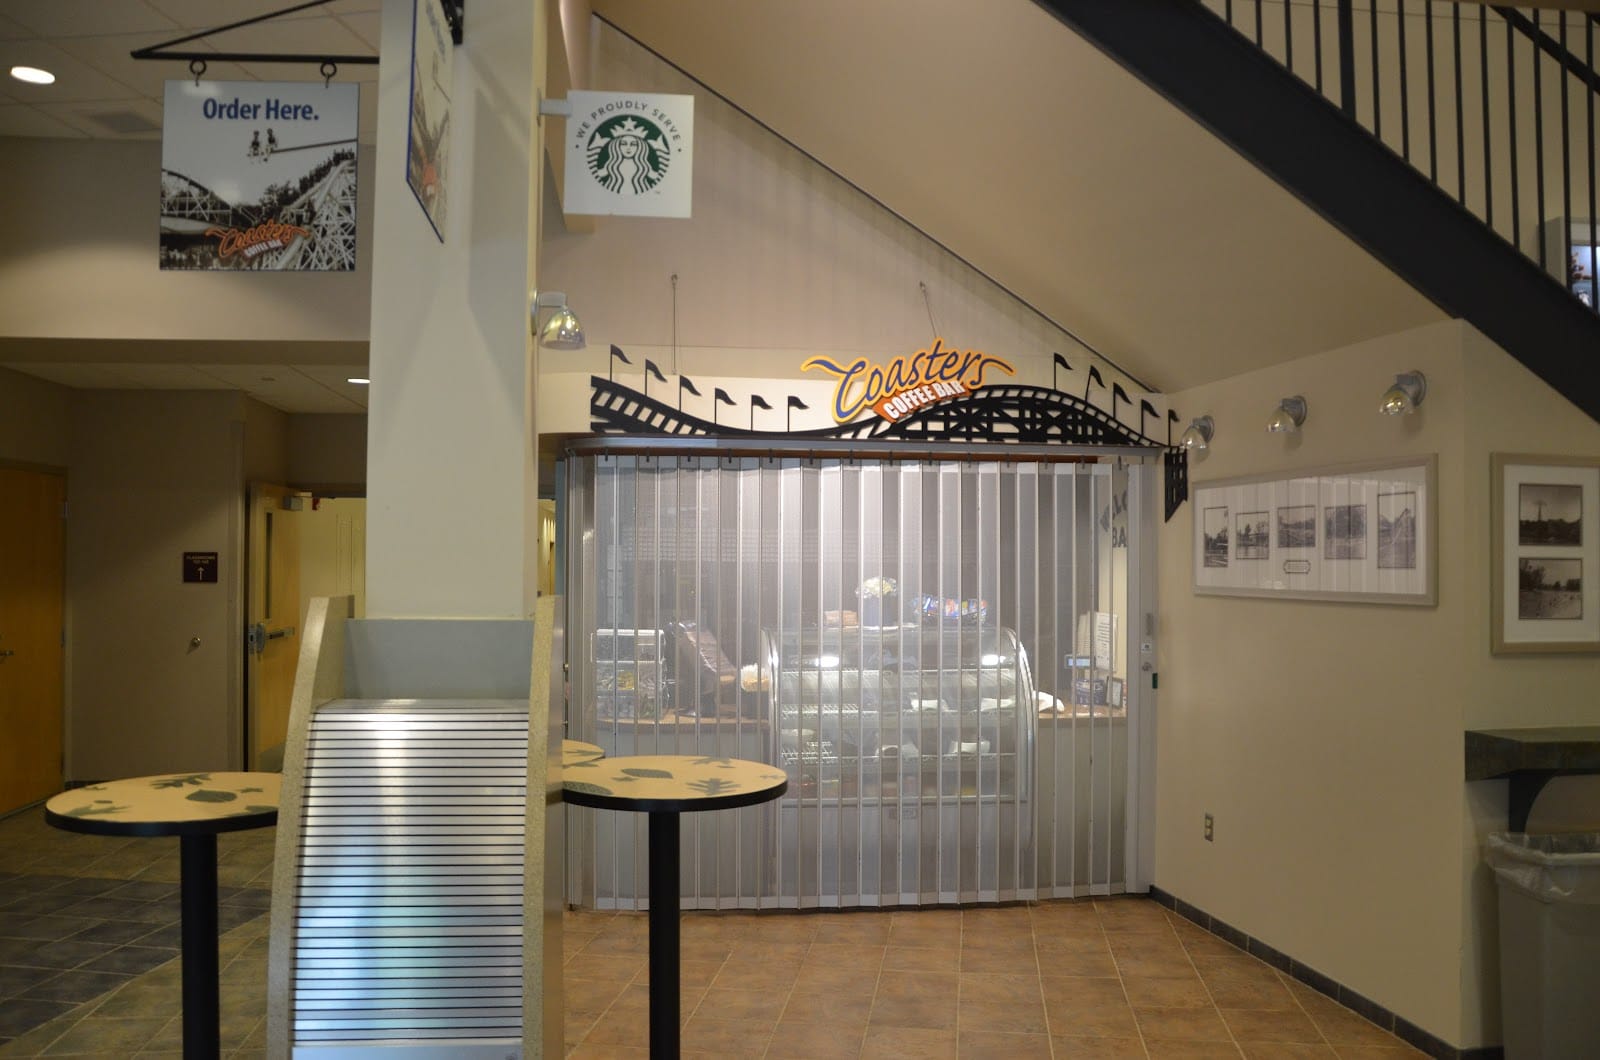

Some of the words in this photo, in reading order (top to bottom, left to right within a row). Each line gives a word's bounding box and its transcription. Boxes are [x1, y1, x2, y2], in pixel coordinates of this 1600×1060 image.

[203, 98, 260, 120] Order
[265, 99, 319, 120] Here.
[576, 120, 590, 139] WE
[591, 100, 648, 121] PROUDLY
[652, 109, 681, 141] SERVE
[803, 338, 1016, 421] Coasters
[883, 385, 936, 419] COFFEE
[933, 380, 966, 398] BAR
